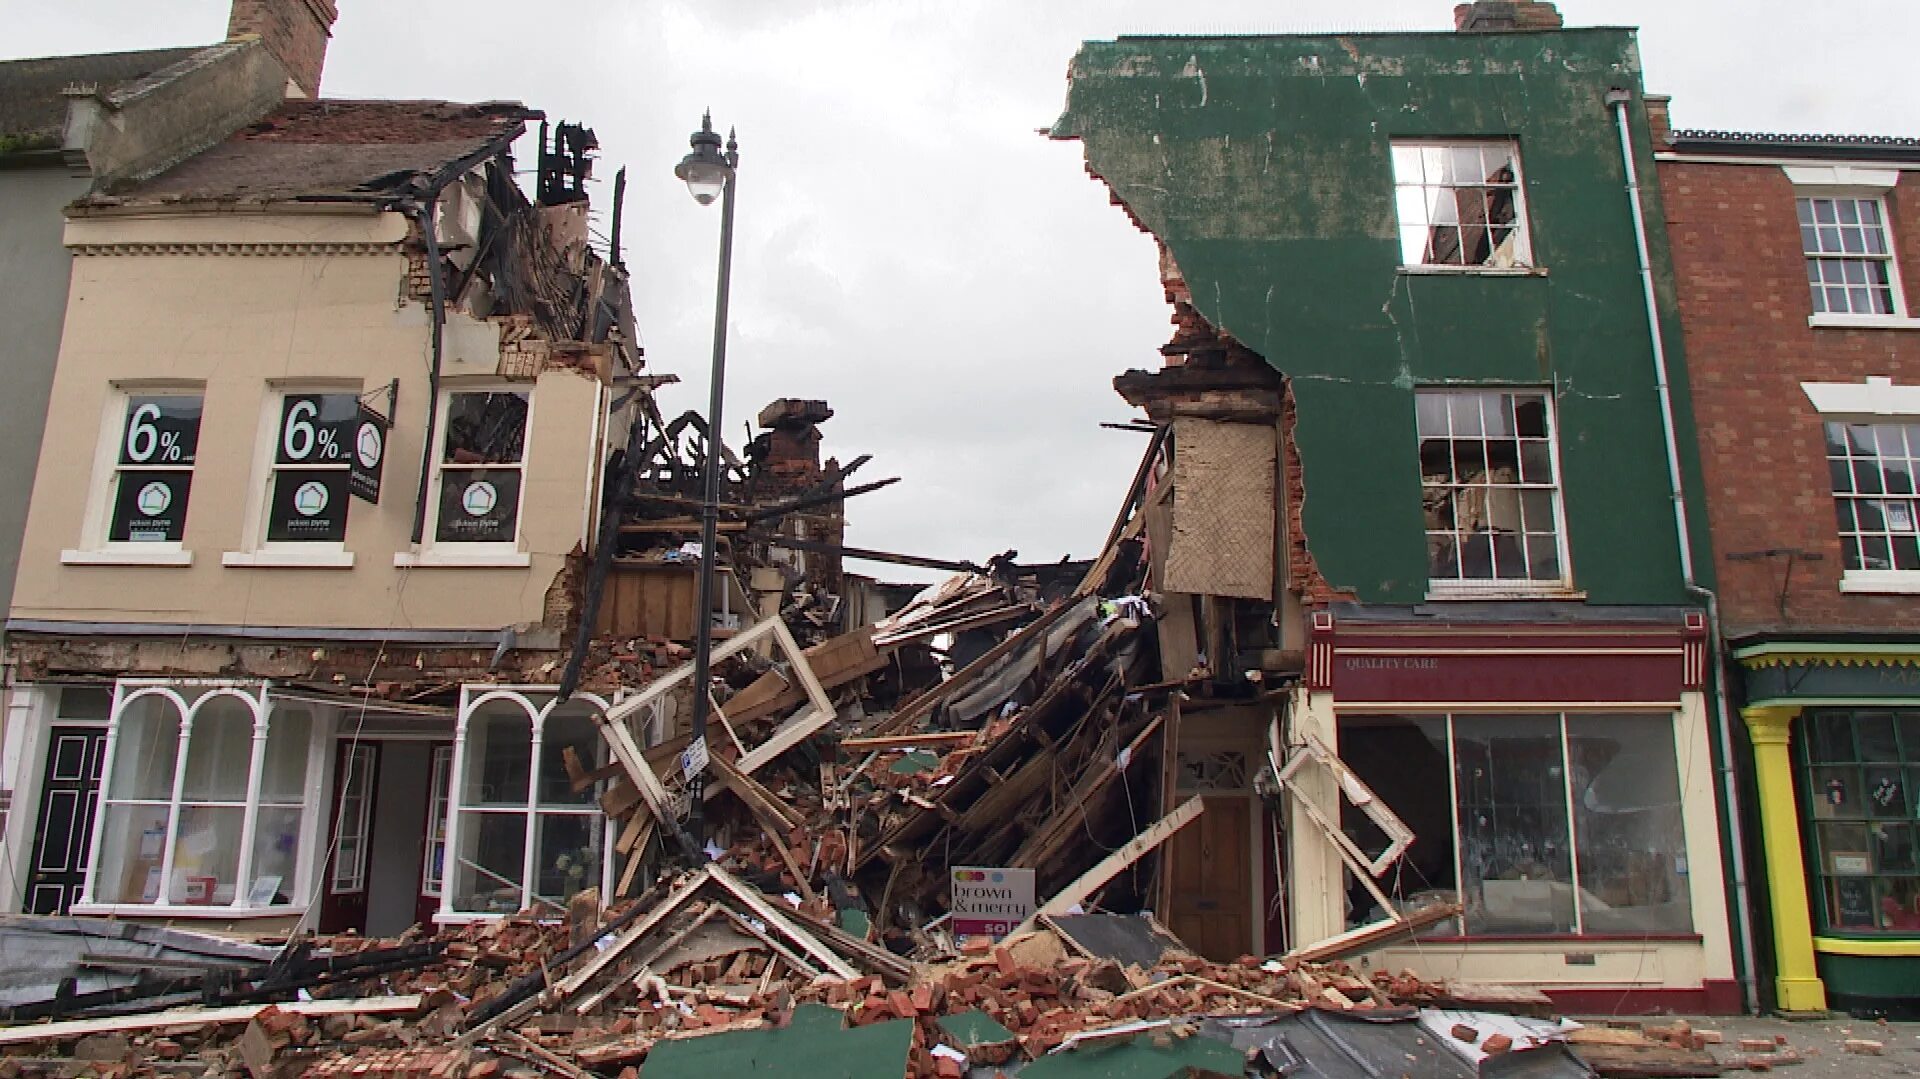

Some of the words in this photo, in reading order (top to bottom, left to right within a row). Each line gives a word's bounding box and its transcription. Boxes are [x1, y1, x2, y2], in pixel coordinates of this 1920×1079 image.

[1346, 657, 1400, 670] QUALITY
[1404, 657, 1438, 669] CARE
[954, 883, 1012, 899] brown
[955, 897, 968, 912] &
[971, 901, 1026, 918] merry
[984, 920, 1020, 934] sol
